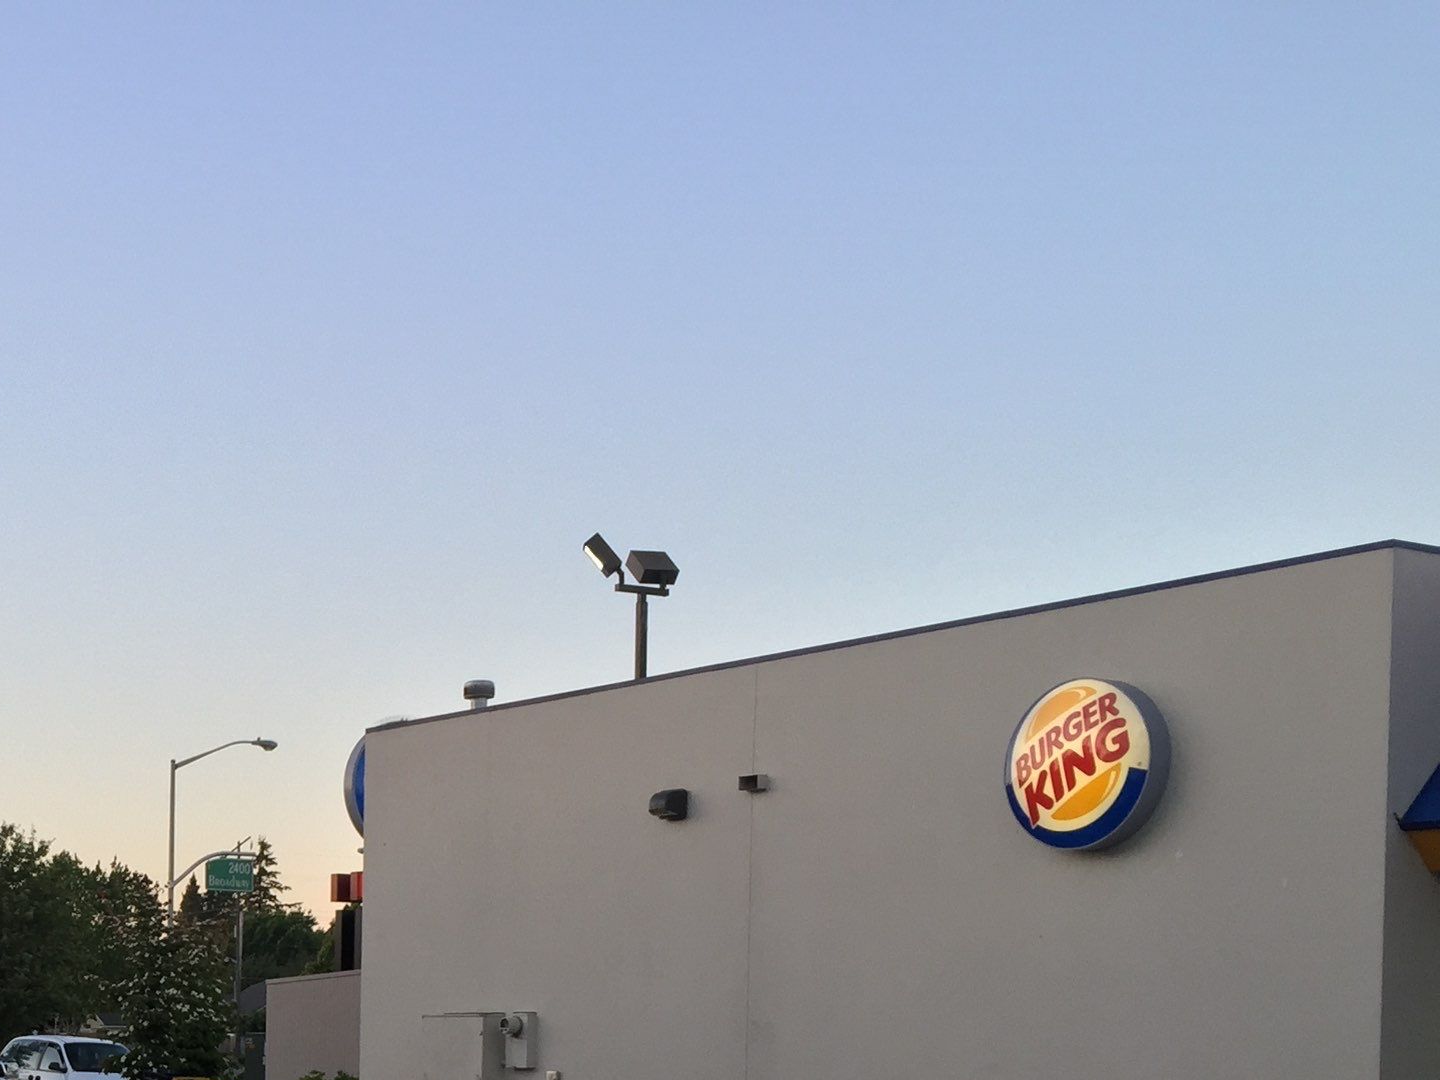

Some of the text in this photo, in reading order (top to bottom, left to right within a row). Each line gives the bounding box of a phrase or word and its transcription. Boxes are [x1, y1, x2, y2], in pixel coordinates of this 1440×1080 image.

[1015, 692, 1120, 788] BURGER
[1024, 717, 1130, 828] KING
[228, 862, 250, 875] 2400
